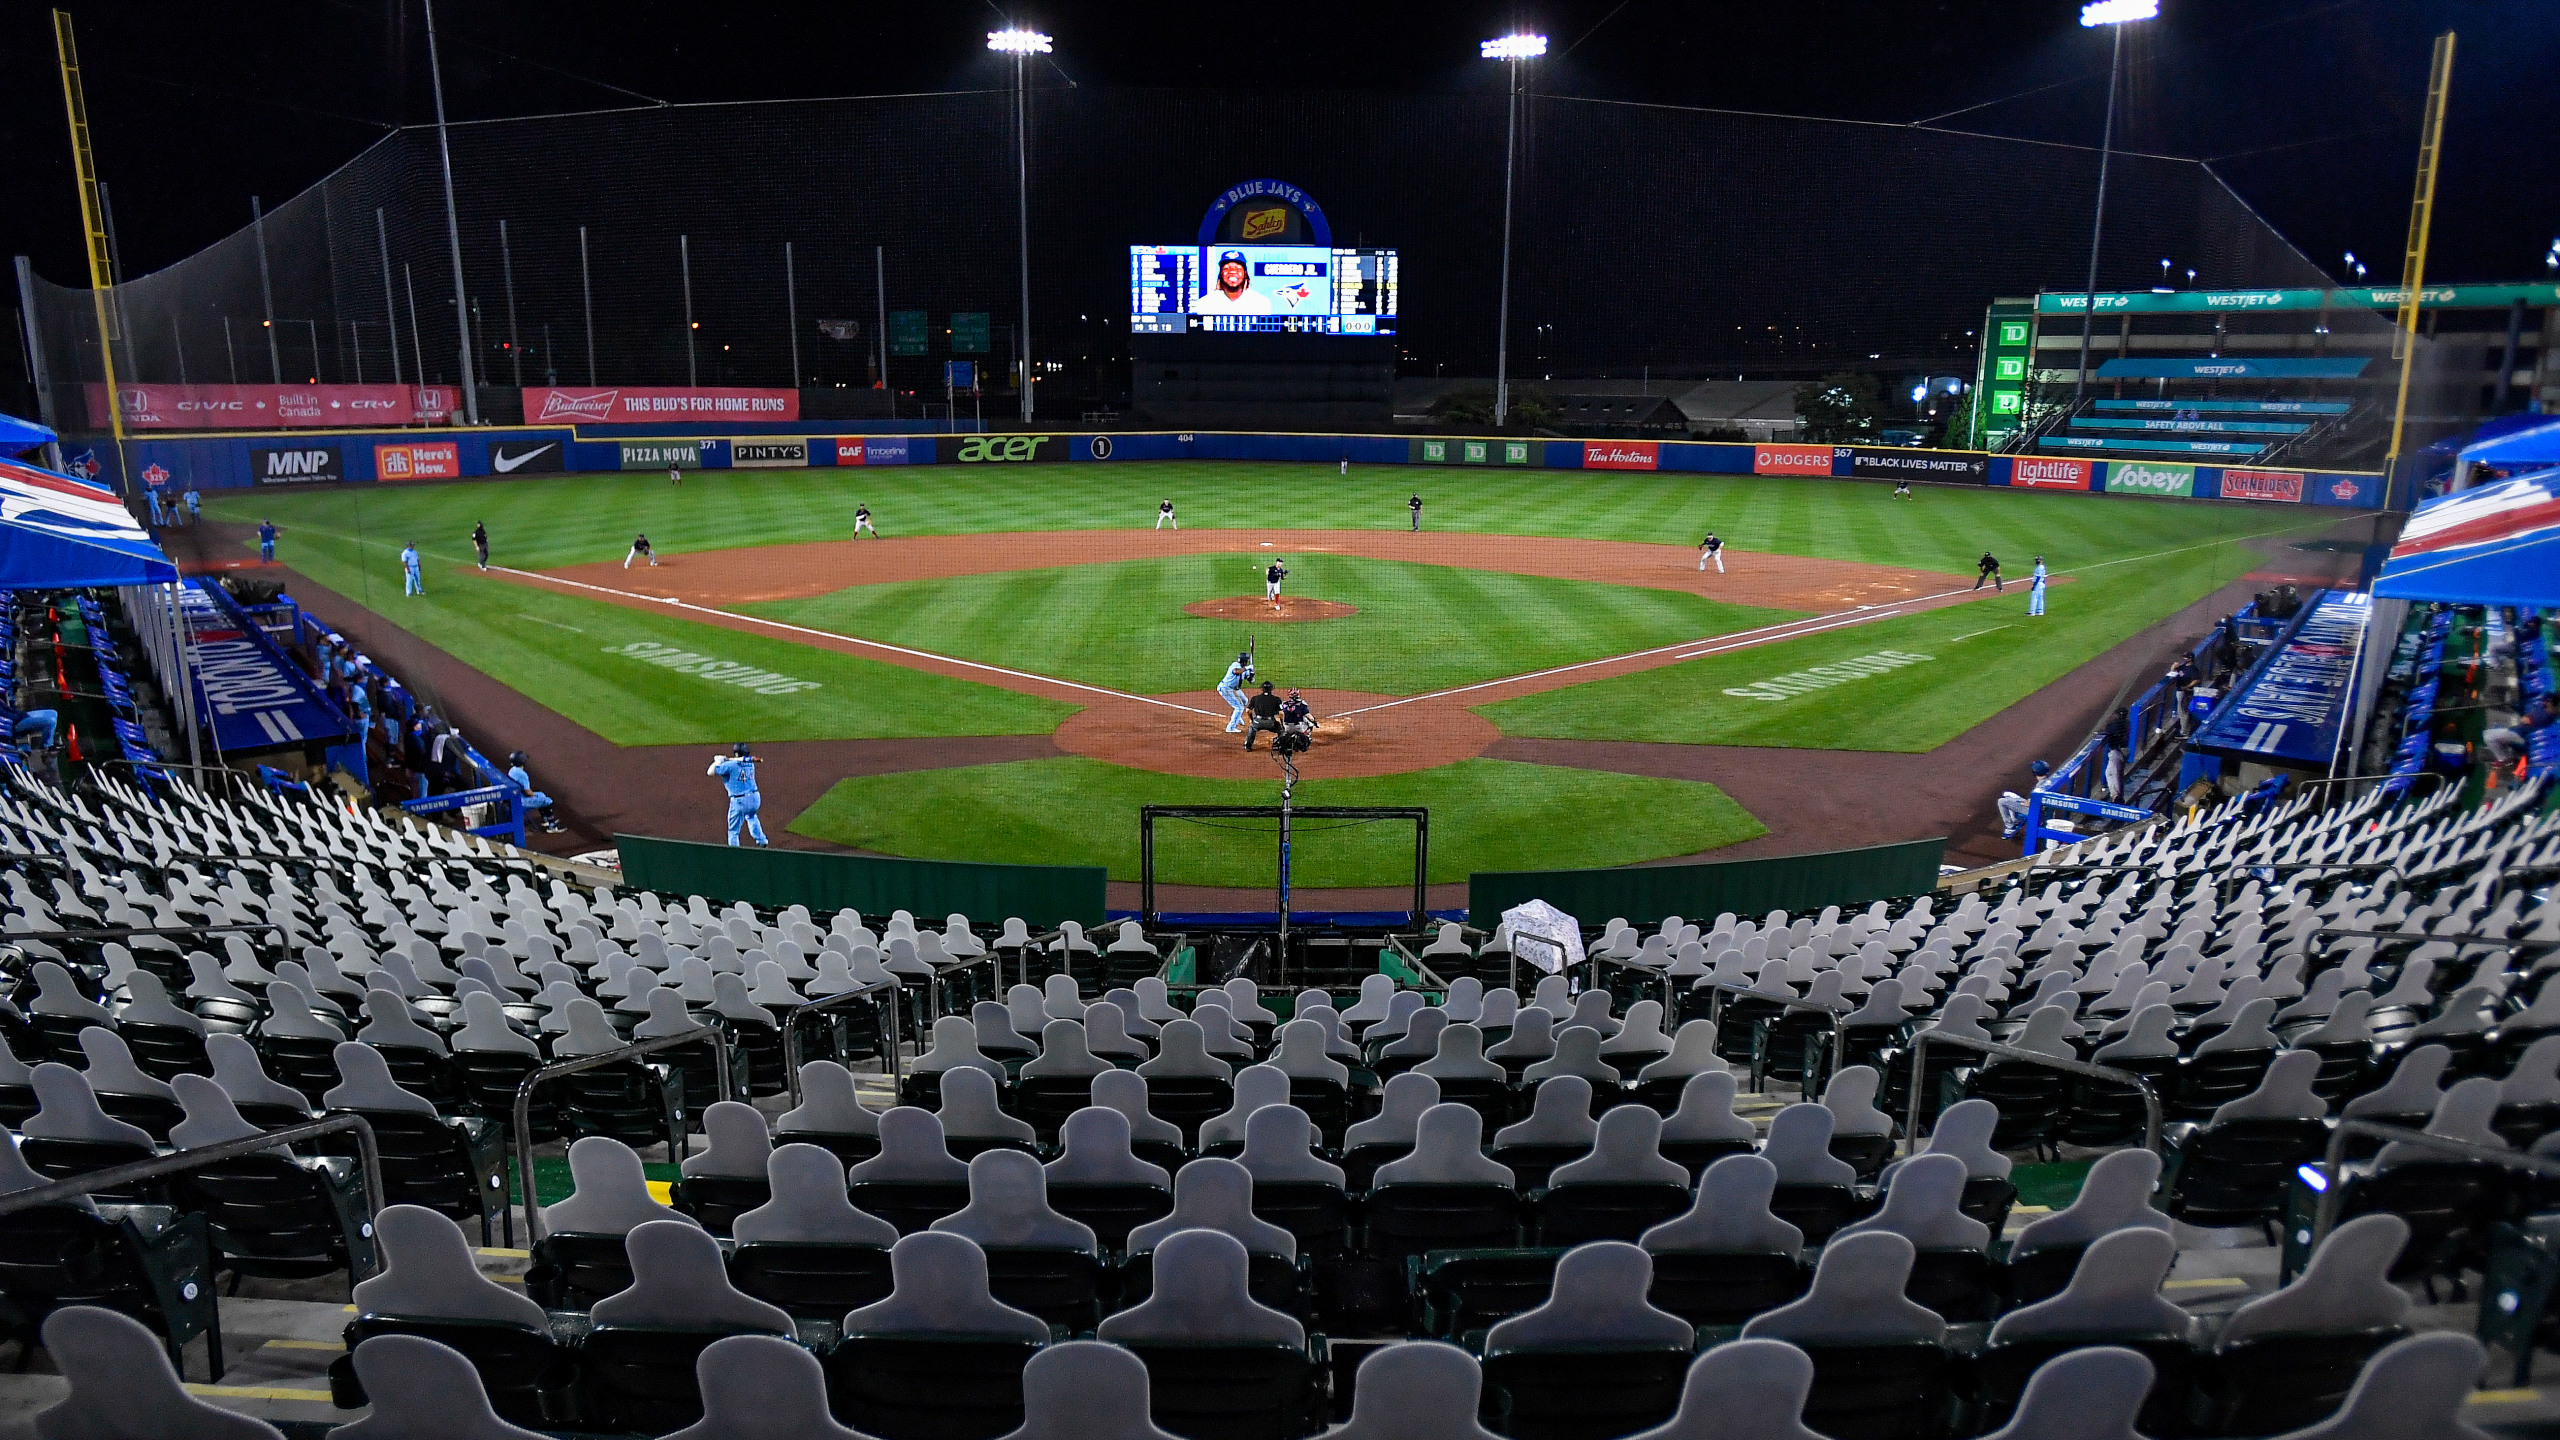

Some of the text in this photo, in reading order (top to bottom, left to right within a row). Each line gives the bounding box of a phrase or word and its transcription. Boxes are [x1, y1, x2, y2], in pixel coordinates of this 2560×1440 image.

[1228, 181, 1302, 203] BLUE JAYS
[2060, 297, 2115, 309] WESJET
[2207, 294, 2267, 308] WESTJET
[2003, 325, 2025, 341] TD
[2000, 360, 2021, 376] TD
[2194, 365, 2235, 376] WESTJET
[177, 401, 243, 410] CIVIC
[279, 394, 318, 405] Built in
[351, 400, 396, 409] CR-V
[549, 398, 609, 412] Budweiser
[624, 398, 785, 411] THIS BUD'S FOR HOME RUNS
[2136, 401, 2164, 409] WESTJET
[278, 406, 321, 417] Canada
[2260, 403, 2292, 411] WESTJET
[2145, 420, 2223, 430] SAFETY ABOVE ALL
[700, 439, 716, 450] 371
[1177, 433, 1194, 443] 404
[2067, 438, 2096, 446] WESTJET
[738, 446, 802, 459] PINTY'S
[838, 446, 862, 457] GAF
[958, 436, 1049, 462] acer
[1428, 445, 1443, 457] TD
[1468, 445, 1484, 458] TD
[1509, 446, 1525, 459] TD
[1834, 449, 1852, 458] 367
[2190, 443, 2223, 452] WESTJET
[413, 449, 452, 461] Here's
[623, 446, 696, 463] PIZZA NOVA
[1588, 448, 1653, 463] Tim Hortons
[1774, 454, 1830, 467] ROGERS
[268, 450, 329, 475] MNP
[415, 463, 446, 475] How.
[1869, 457, 1968, 472] BLACK LIVES MATTER
[2110, 463, 2190, 492] Sobeys
[2225, 474, 2298, 496] SCHNEIDERS
[464, 791, 502, 804] SAMSUNG
[2041, 797, 2079, 810] SAMSUNG
[410, 800, 450, 812] SAMSUNG
[2100, 807, 2141, 821] SAMSUNG
